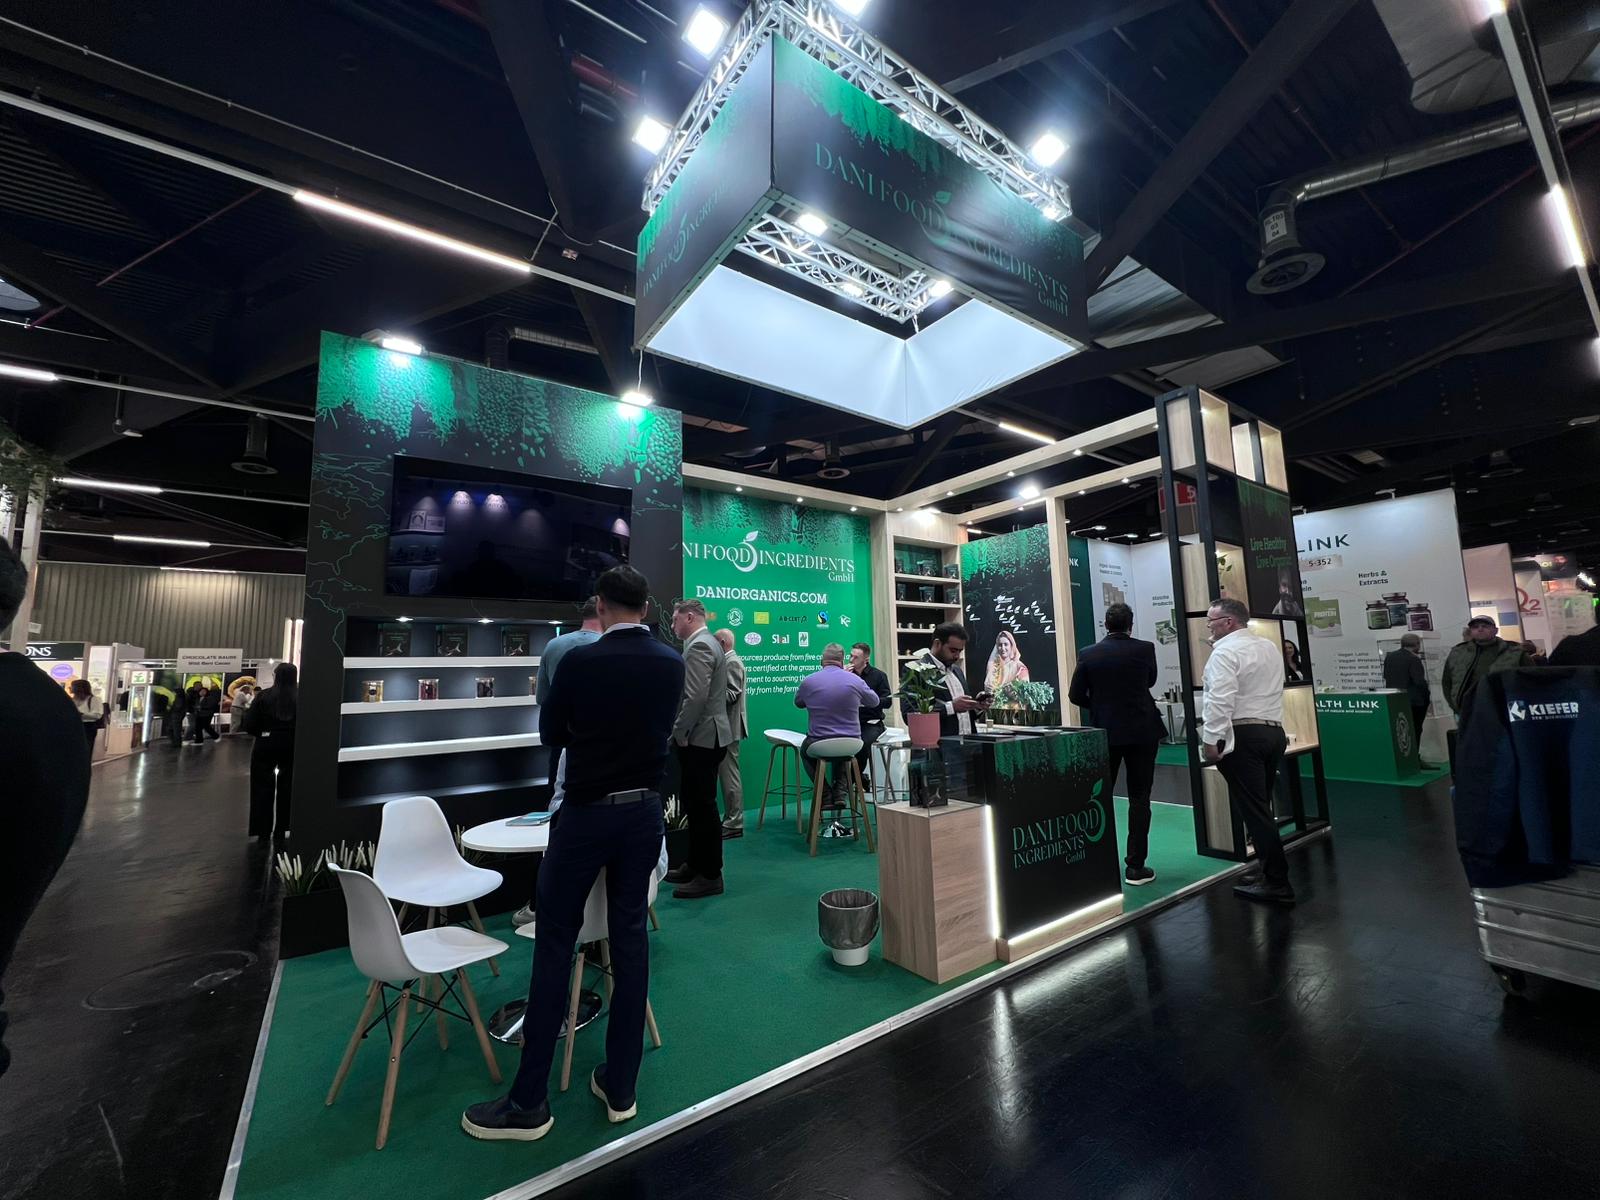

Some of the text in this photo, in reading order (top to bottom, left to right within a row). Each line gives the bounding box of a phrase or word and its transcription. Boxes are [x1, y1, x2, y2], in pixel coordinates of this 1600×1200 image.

[816, 142, 873, 195] DANI
[1038, 290, 1070, 317] GmbH
[1298, 533, 1350, 553] INK
[704, 543, 756, 569] FOOD
[760, 549, 855, 573] INGREDIENTS
[1308, 558, 1332, 567] 5-352
[828, 571, 855, 583] GmbH
[1358, 571, 1379, 579] Herbs
[1359, 578, 1389, 587] Extracts
[695, 585, 828, 604] DANIORGANICS.COM
[763, 654, 789, 662] produce
[789, 653, 805, 662] from
[805, 653, 816, 662] five
[753, 663, 779, 673] certified
[788, 664, 799, 672] the
[799, 665, 815, 673] grass
[772, 675, 799, 684] sourcing
[755, 686, 772, 695] from
[772, 685, 783, 694] the
[1348, 700, 1380, 709] LINK
[1528, 702, 1579, 716] KIEFER
[1012, 806, 1103, 851] DANI FOOD
[1013, 834, 1085, 869] INGREDIENTS
